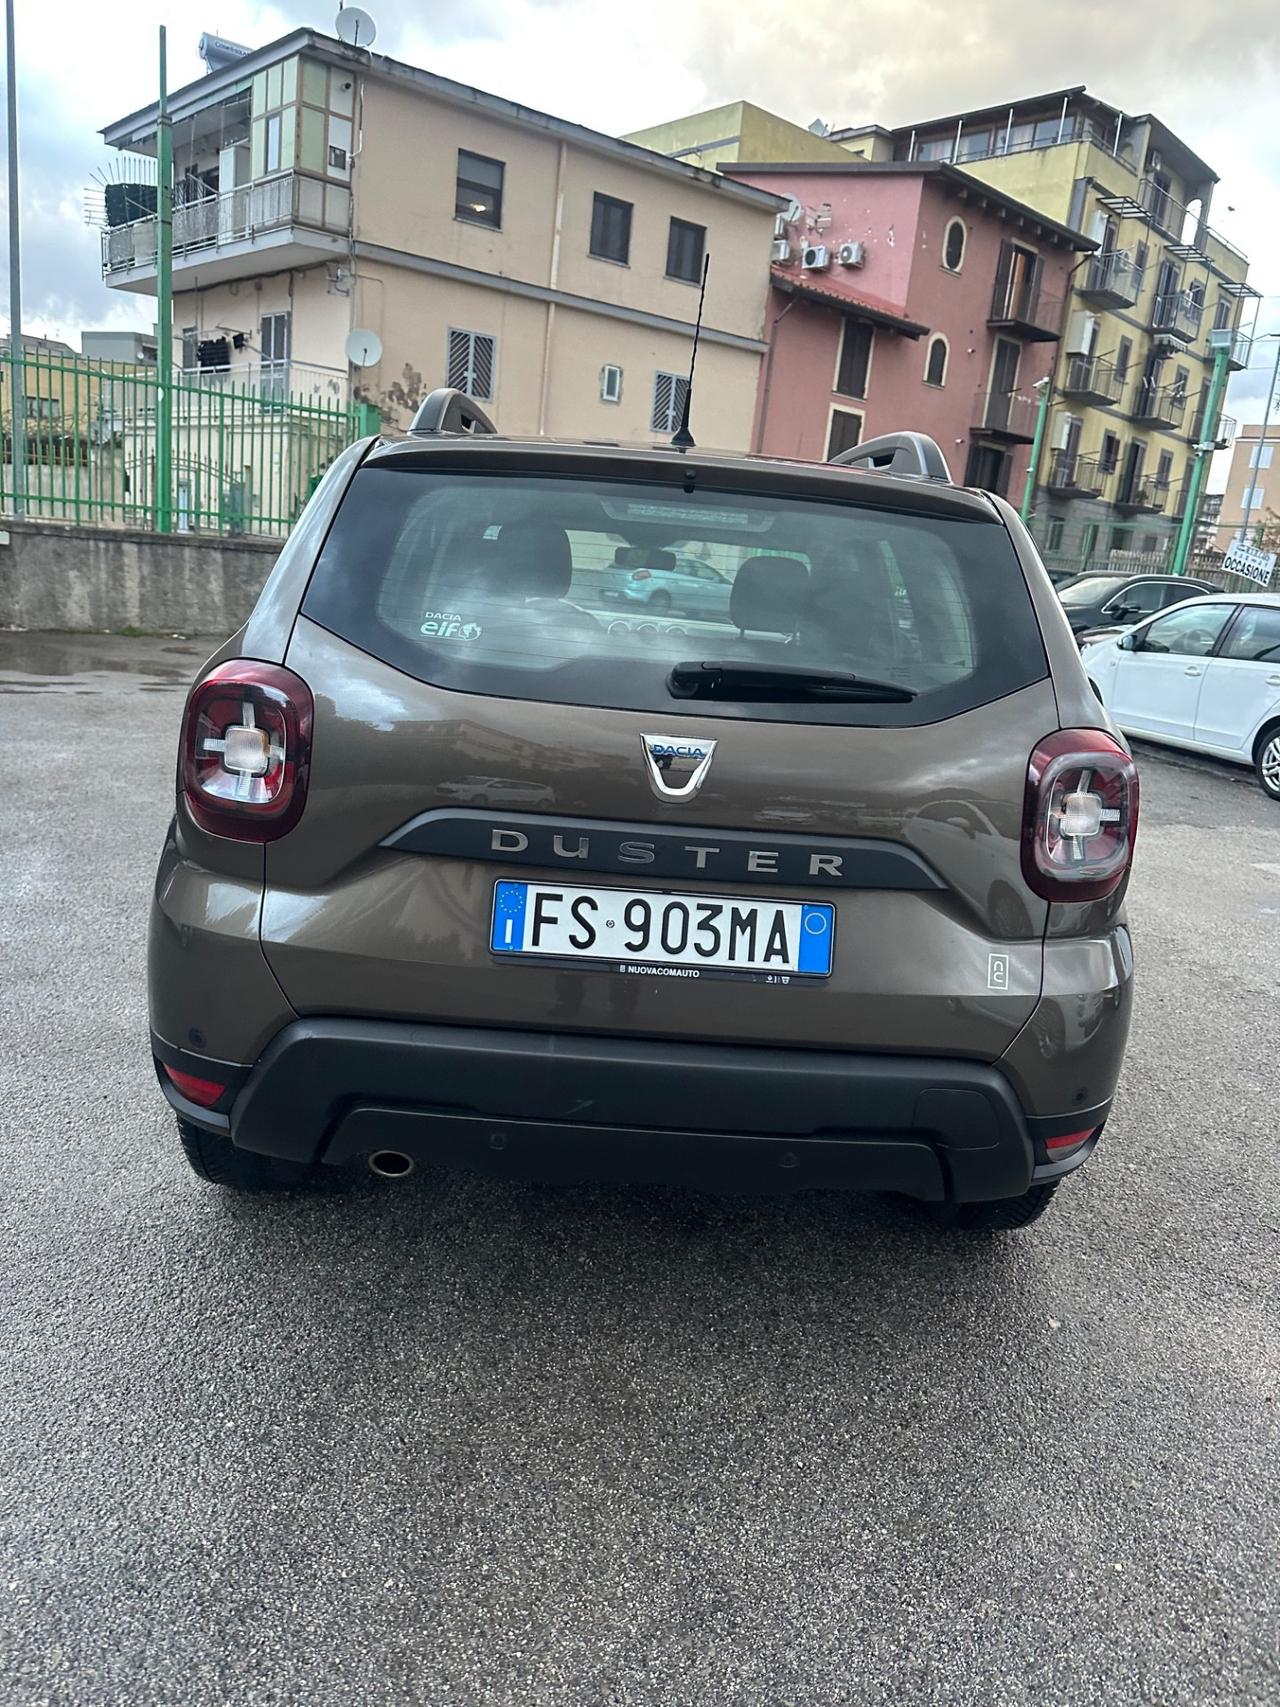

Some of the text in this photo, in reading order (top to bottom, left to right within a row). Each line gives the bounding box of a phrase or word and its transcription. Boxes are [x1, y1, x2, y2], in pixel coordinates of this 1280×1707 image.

[1225, 557, 1270, 584] OCCASIONE
[425, 611, 461, 621] DACIA
[652, 744, 704, 757] DACIA
[491, 828, 843, 877] DUSTER
[627, 965, 700, 978] NUOVACOMAUTO
